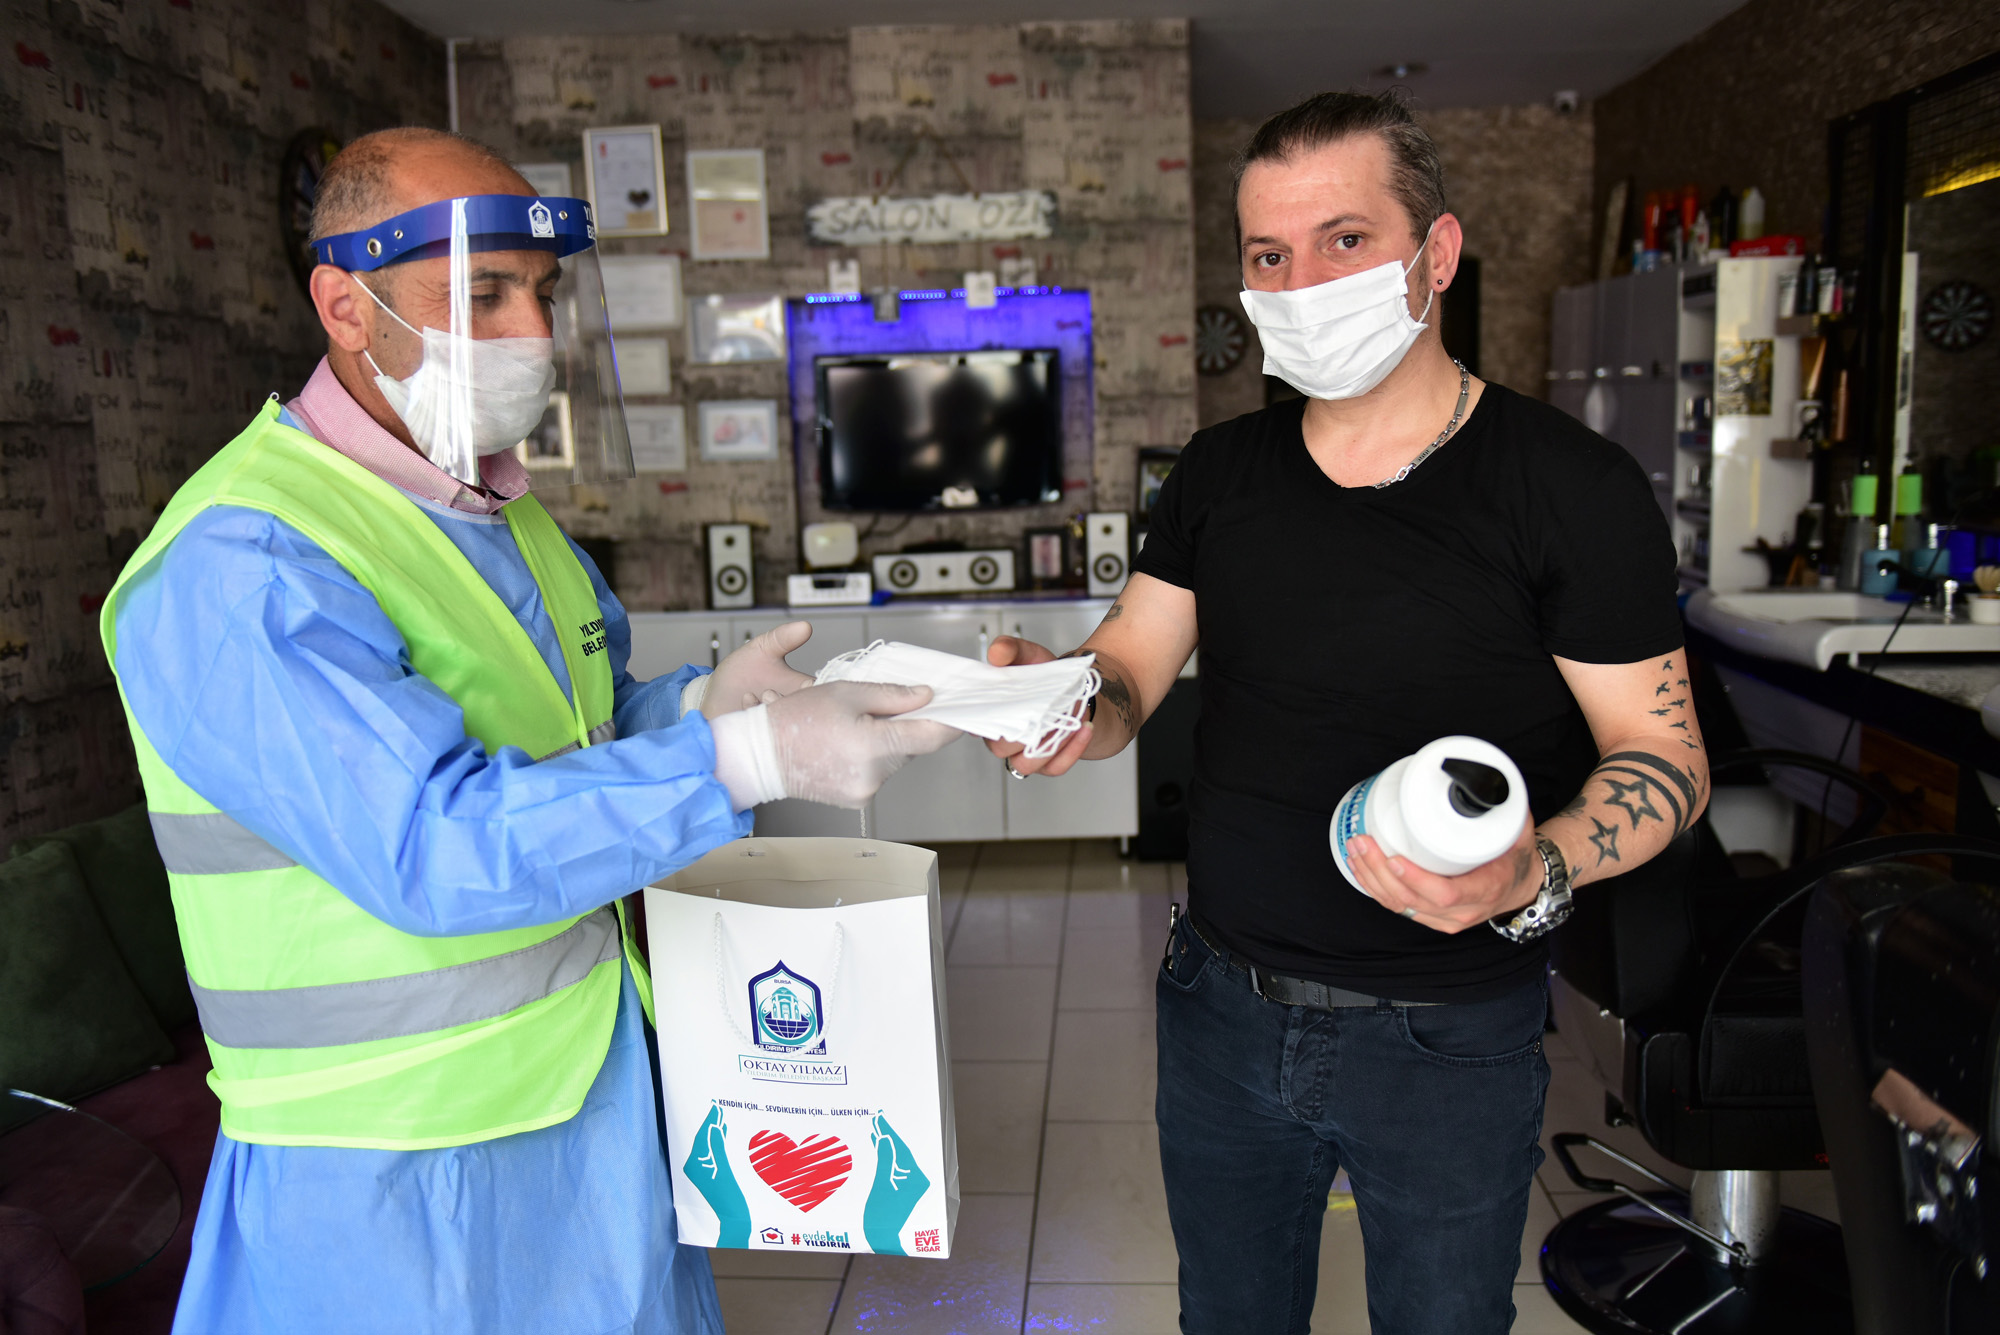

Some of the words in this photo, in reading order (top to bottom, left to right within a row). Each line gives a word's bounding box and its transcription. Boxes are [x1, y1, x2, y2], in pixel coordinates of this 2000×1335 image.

[744, 1059, 787, 1072] OKTAY
[790, 1064, 843, 1076] YILMAZ
[914, 1228, 939, 1237] HAYAT
[804, 1239, 851, 1249] YILDIRIM
[915, 1235, 940, 1246] EVE
